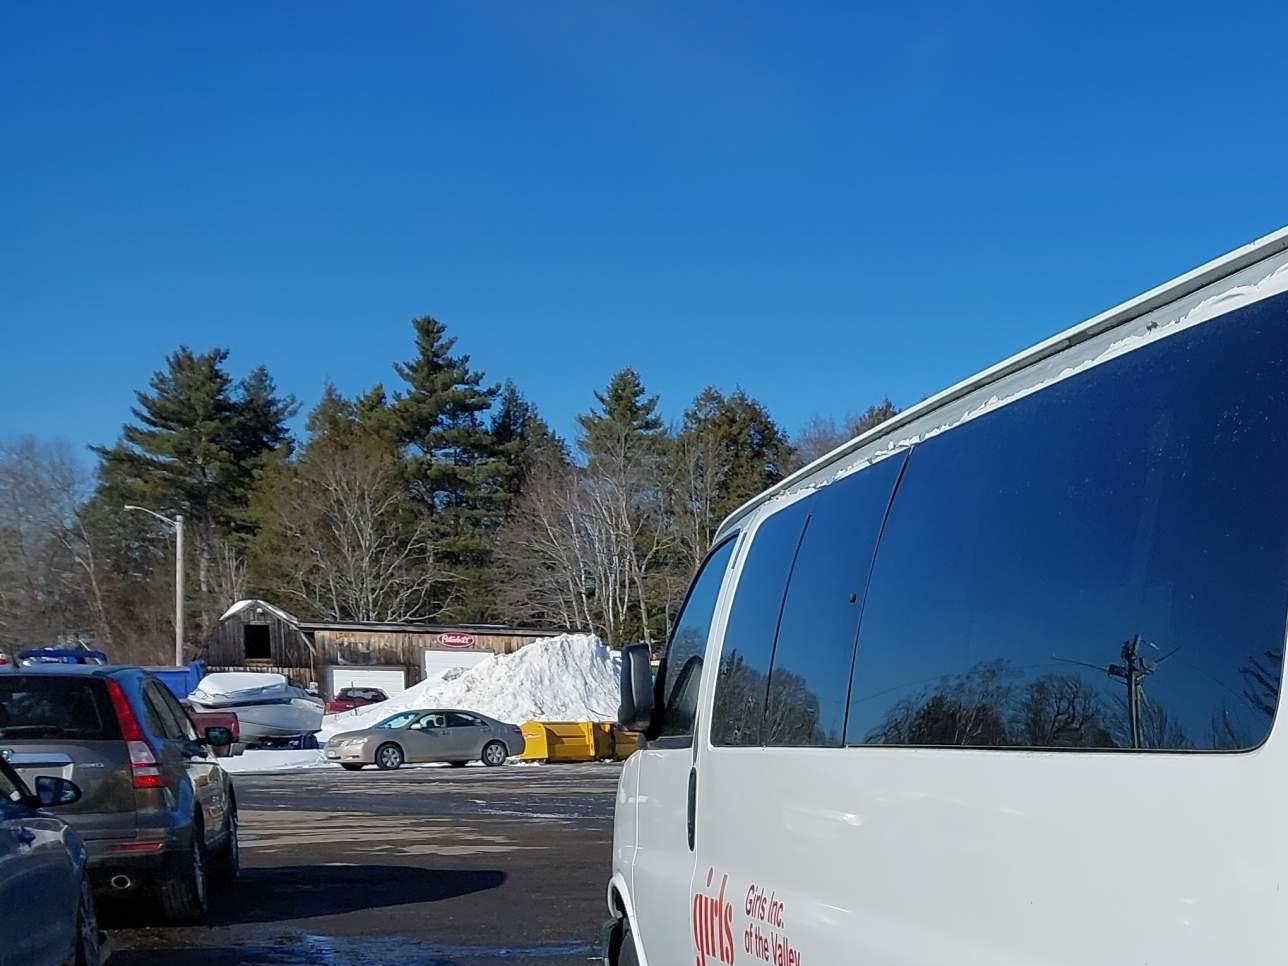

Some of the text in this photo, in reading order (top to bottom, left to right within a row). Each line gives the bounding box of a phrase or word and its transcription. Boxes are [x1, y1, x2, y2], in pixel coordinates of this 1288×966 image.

[745, 885, 784, 928] Girls Inc.
[744, 924, 754, 953] of
[754, 930, 770, 961] the
